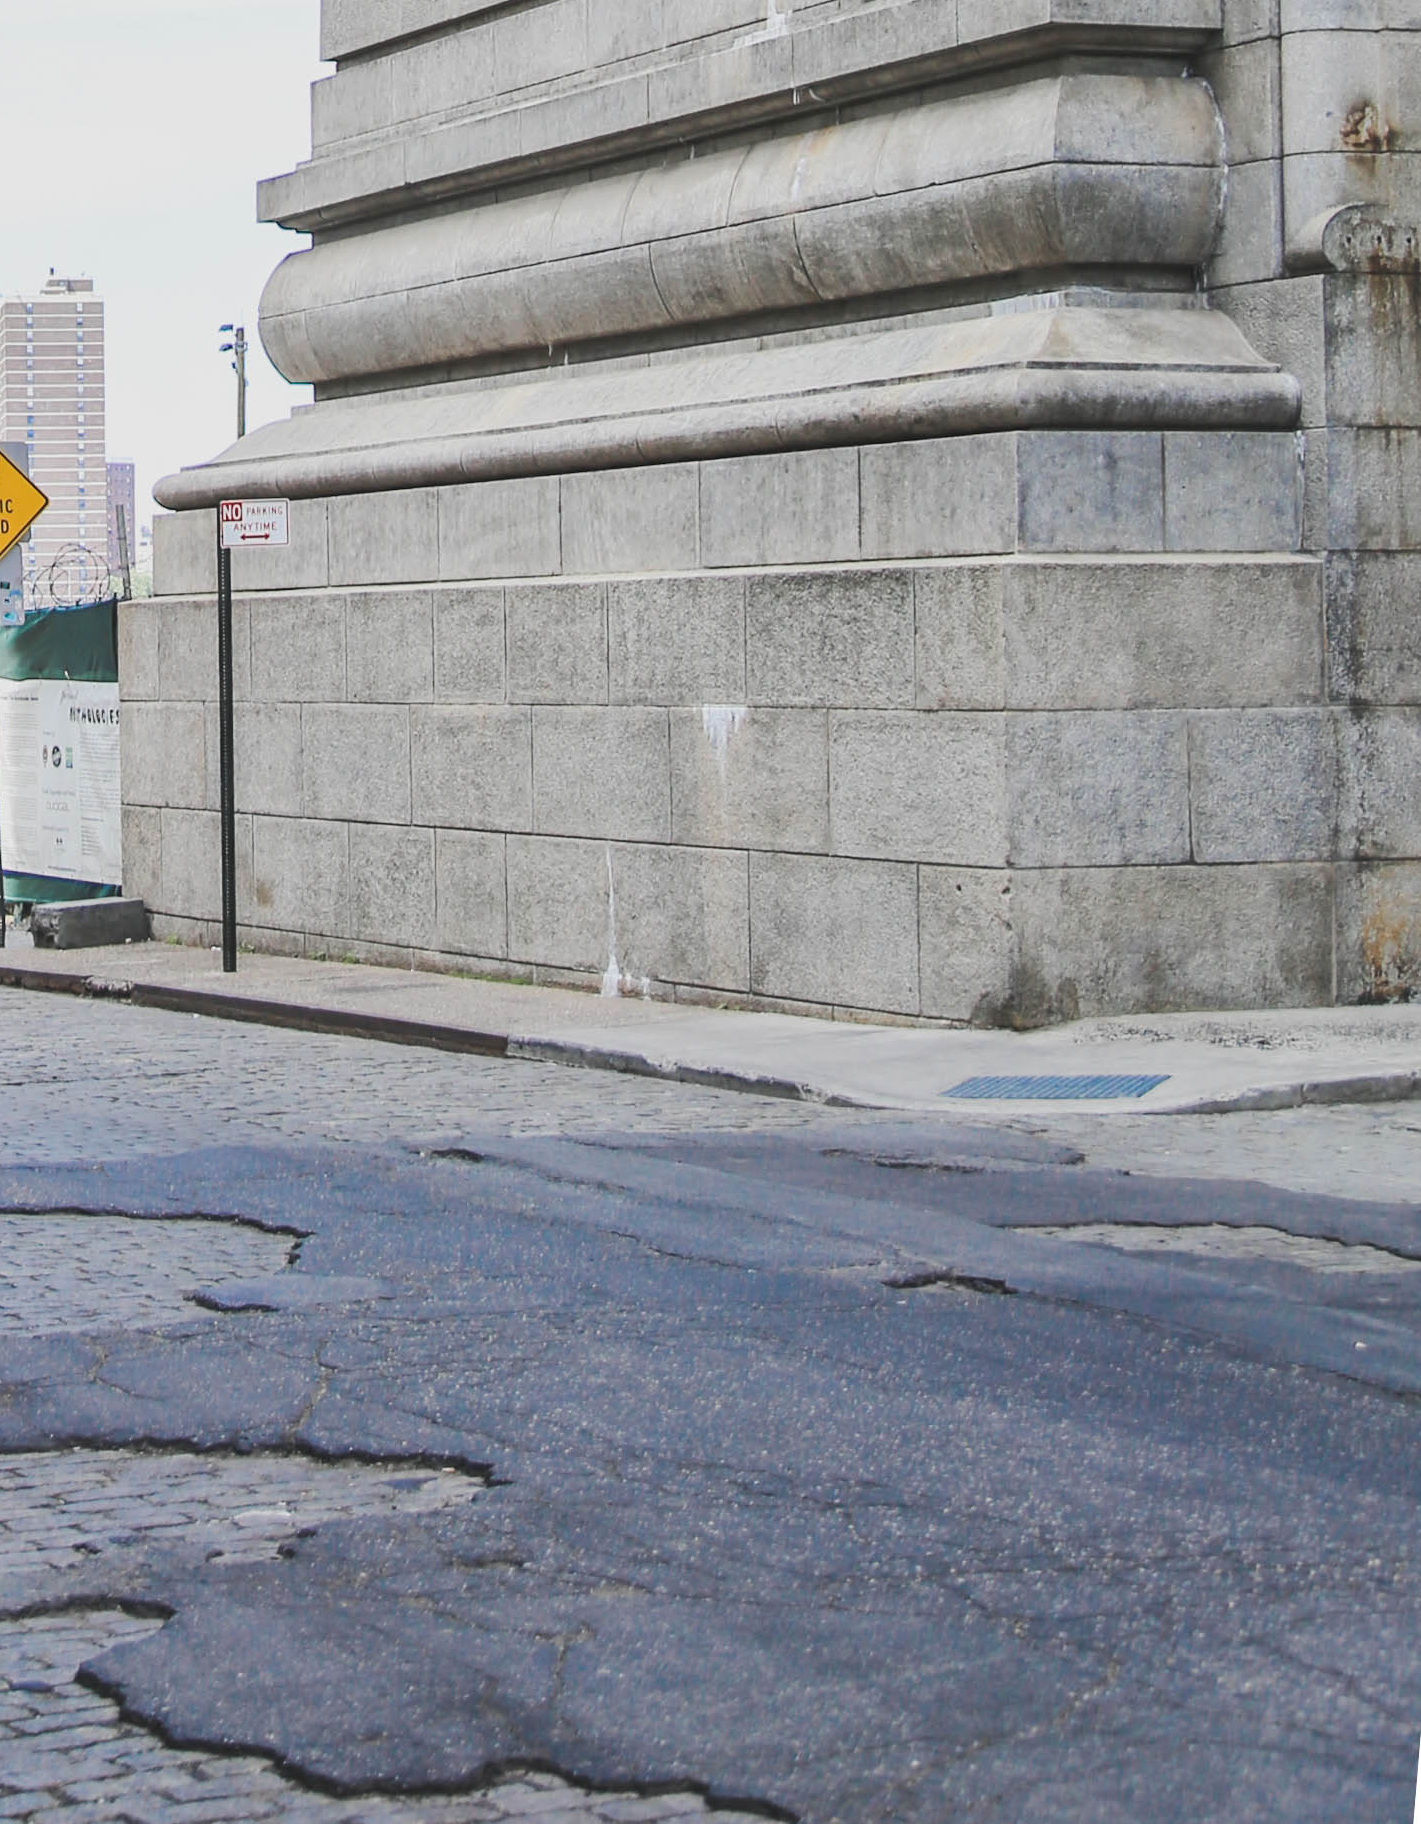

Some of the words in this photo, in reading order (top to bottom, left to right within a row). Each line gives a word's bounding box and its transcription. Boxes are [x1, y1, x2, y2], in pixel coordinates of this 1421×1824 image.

[222, 504, 242, 521] NO
[246, 506, 284, 515] PARKING
[234, 521, 277, 531] ANYTIME
